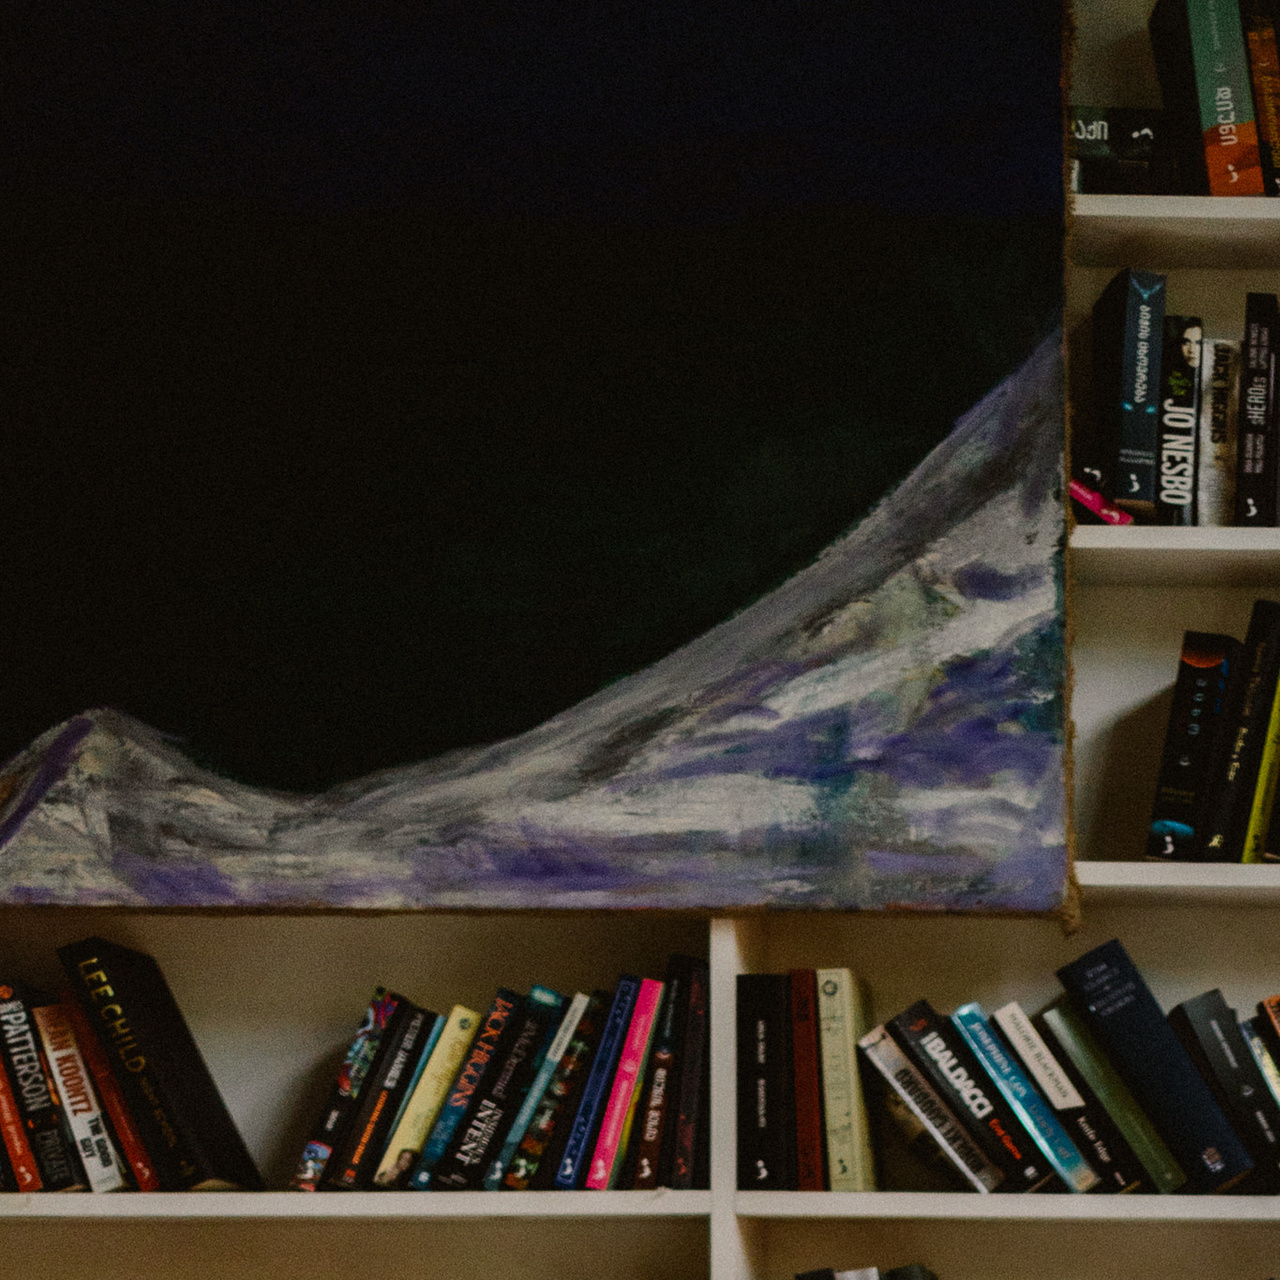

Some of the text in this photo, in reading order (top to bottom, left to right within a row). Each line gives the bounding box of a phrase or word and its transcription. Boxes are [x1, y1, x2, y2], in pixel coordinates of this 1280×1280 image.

[1160, 399, 1195, 505] JO NESBO
[79, 958, 146, 1073] LEE CHILD
[383, 1013, 424, 1089] PETER JAMES
[450, 998, 513, 1107] JACK HIGGINS
[1, 1009, 50, 1112] PATTERSON
[56, 1055, 93, 1116] KOONTZ
[924, 1040, 994, 1119] BALDACCI
[1034, 1052, 1069, 1099] BLACKMAN
[455, 1100, 496, 1166] INTENT
